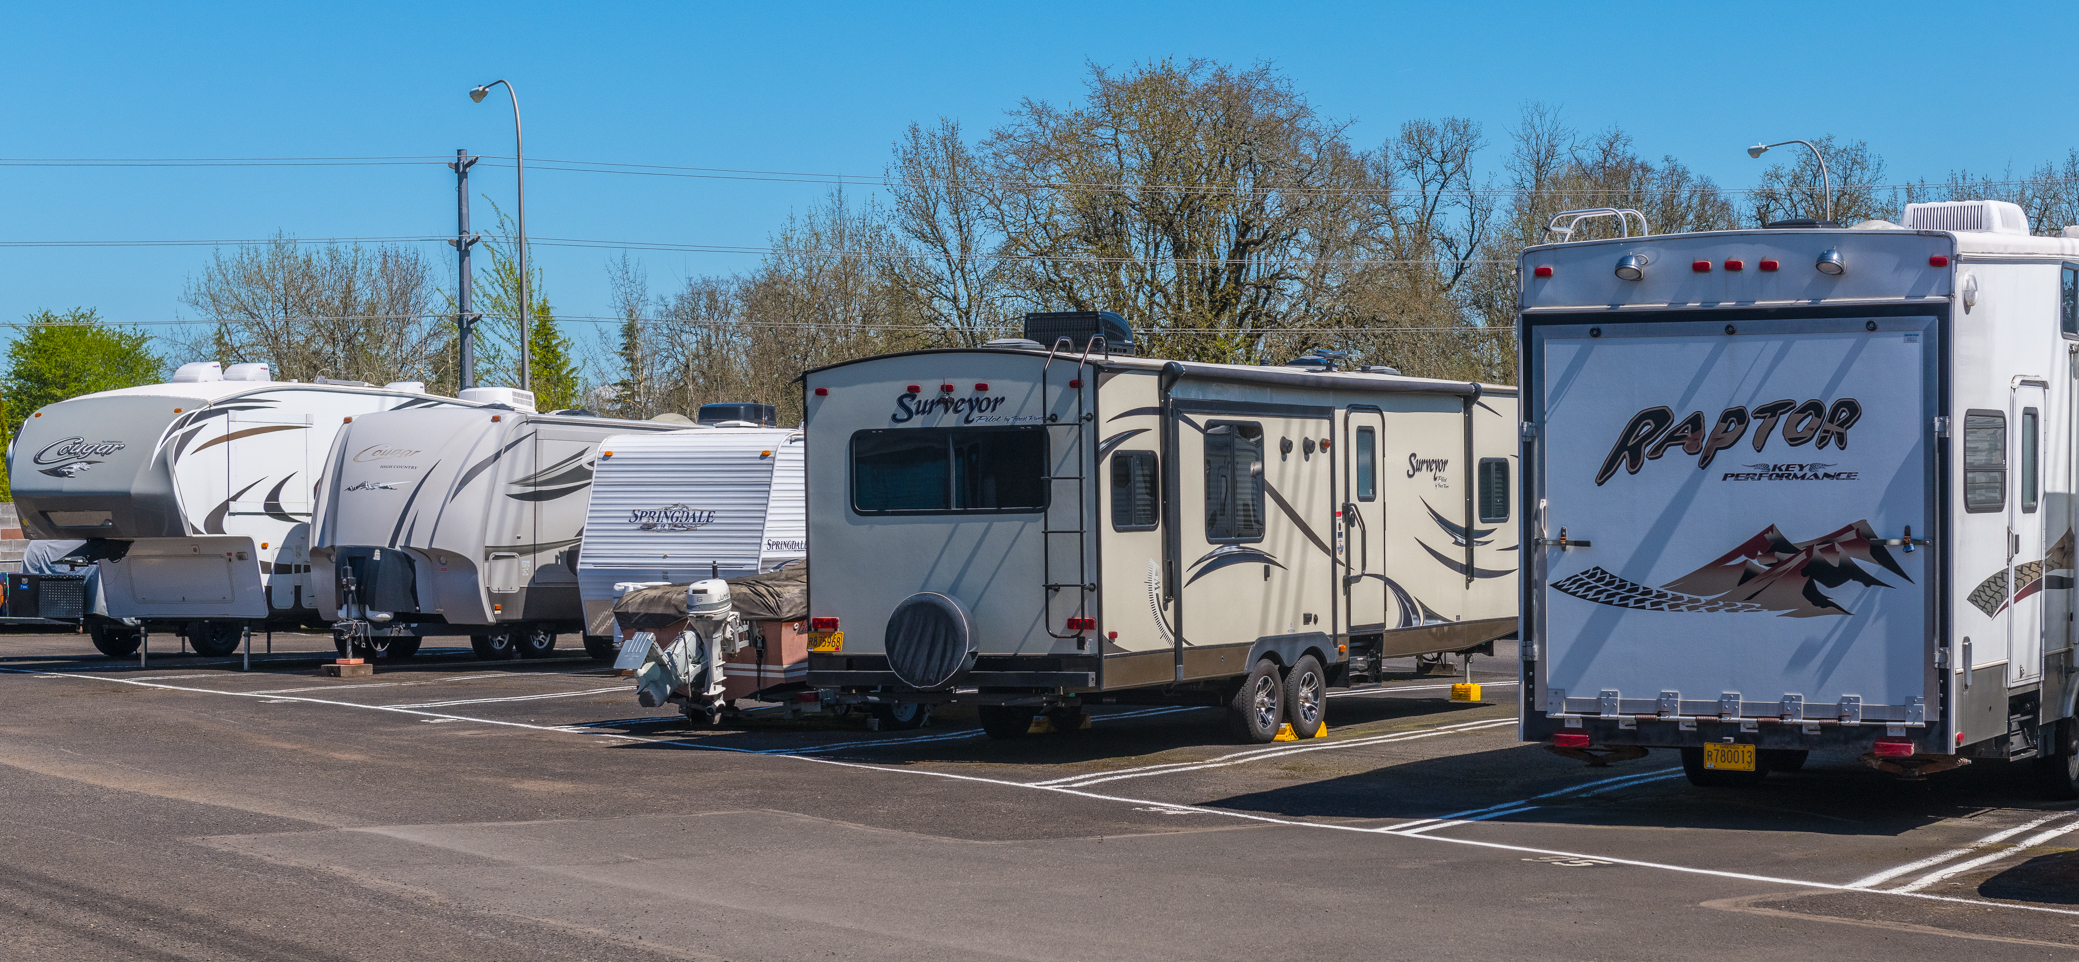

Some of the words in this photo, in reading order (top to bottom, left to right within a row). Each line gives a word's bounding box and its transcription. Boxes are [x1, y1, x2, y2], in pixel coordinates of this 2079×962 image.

[891, 393, 1006, 425] Surveyor
[33, 436, 126, 465] Cougar
[1595, 398, 1862, 487] RAPTOR
[352, 443, 422, 463] Cougar
[1406, 452, 1449, 482] Surveyor
[1771, 463, 1810, 473] KEY
[1721, 472, 1859, 481] PERFORMANCE
[628, 509, 716, 523] SPRINGDALE
[808, 636, 841, 648] R875968
[1706, 749, 1753, 764] R780013
